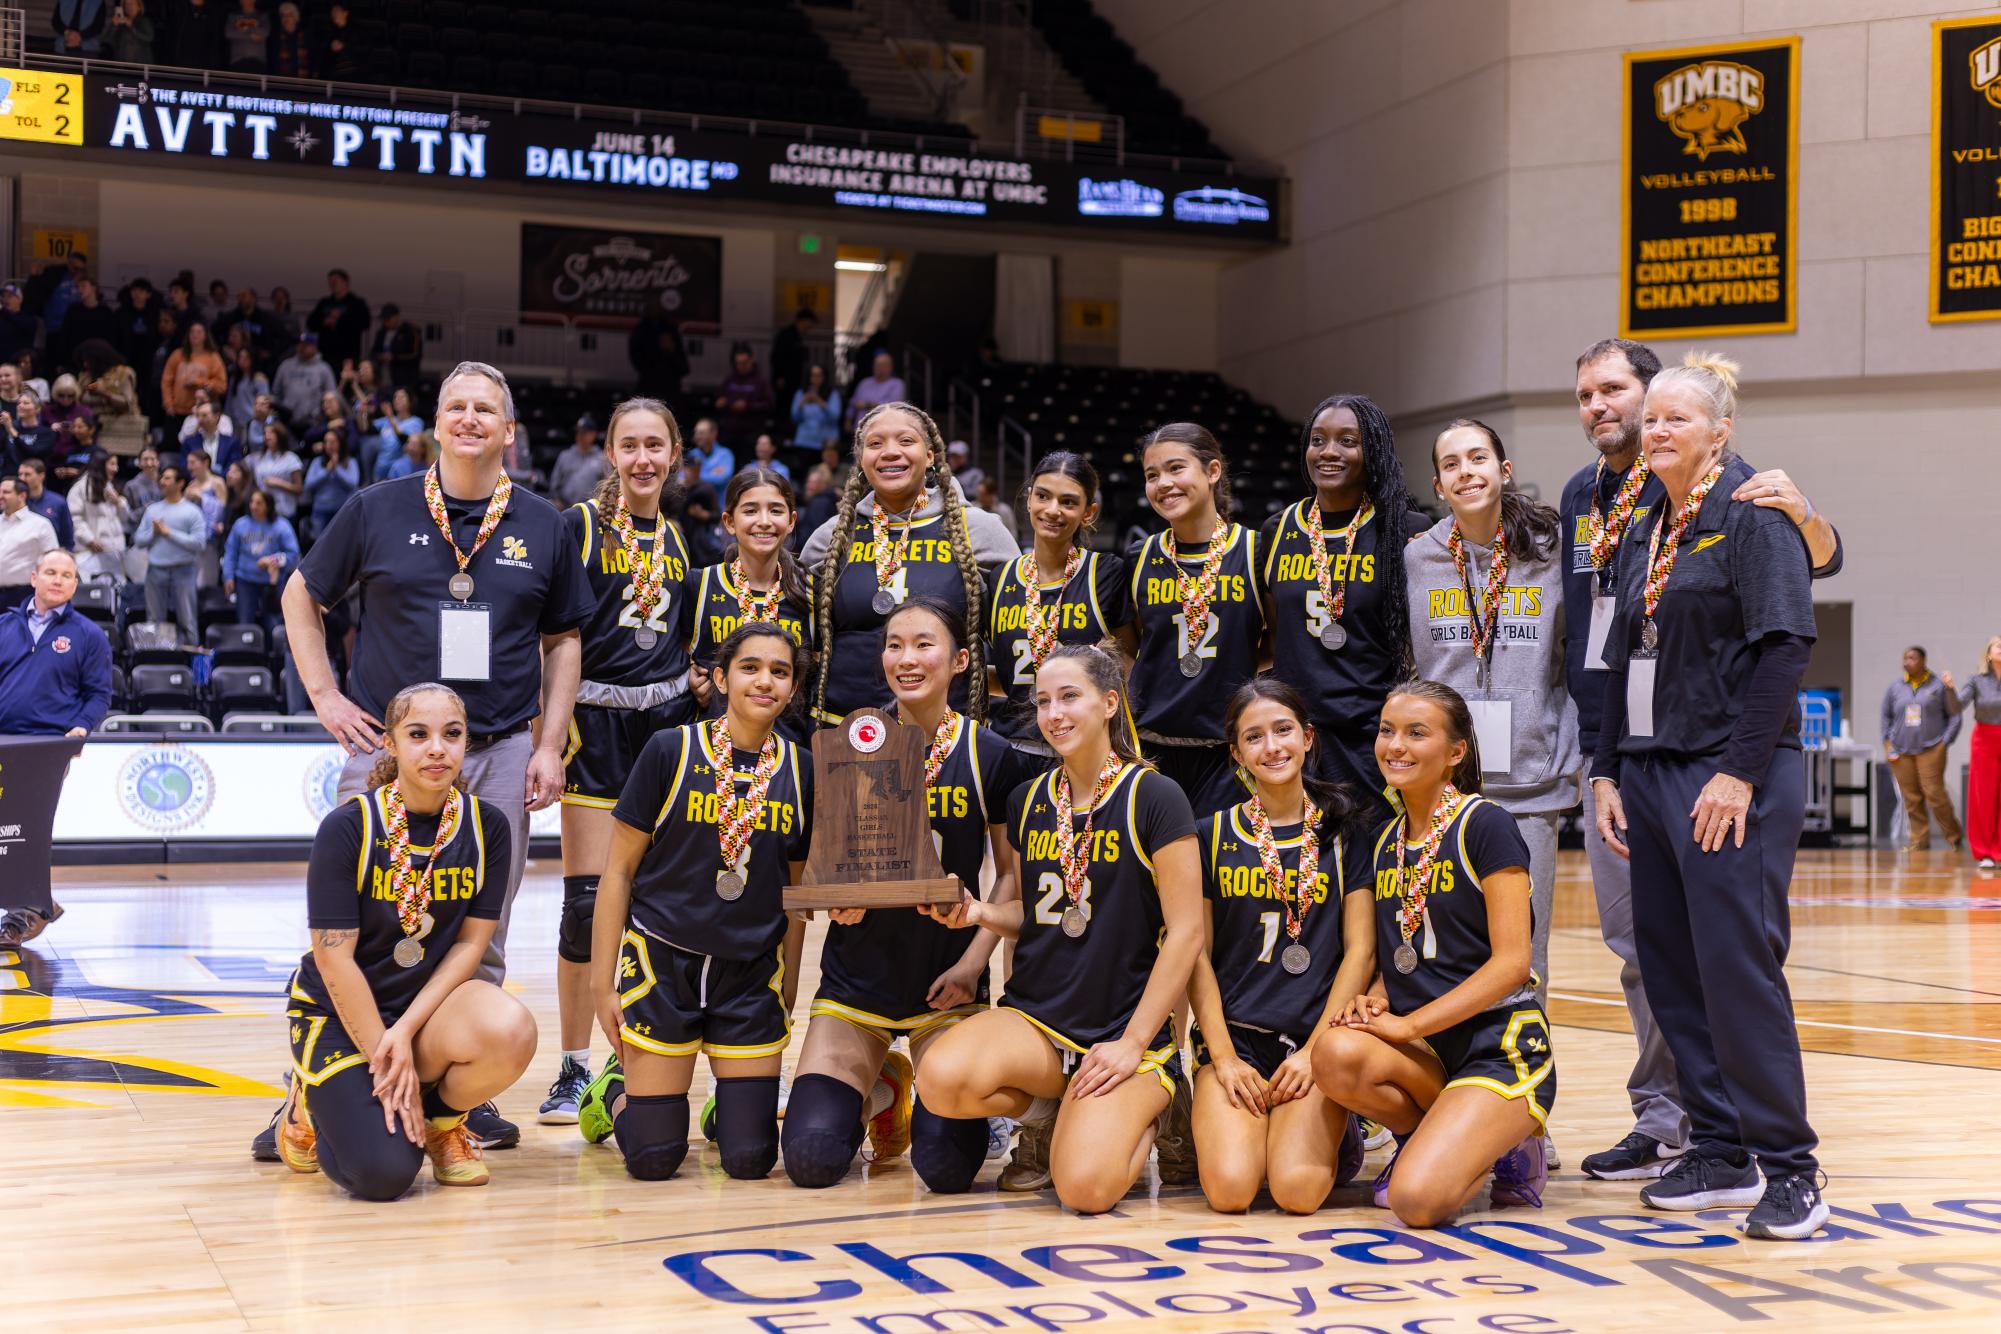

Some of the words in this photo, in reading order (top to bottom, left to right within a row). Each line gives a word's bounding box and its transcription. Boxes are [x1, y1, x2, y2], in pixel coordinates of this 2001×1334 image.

[16, 82, 41, 94] FLS
[54, 83, 70, 105] 2
[151, 88, 178, 104] THE
[180, 91, 225, 108] AVETT
[226, 95, 293, 115] BROTHERS
[309, 102, 342, 120] MIKE
[1660, 64, 1763, 117] UMBC
[14, 115, 42, 128] TOL
[54, 115, 70, 137] 2
[108, 102, 278, 160] AVTT
[332, 121, 487, 178] PTTN
[592, 131, 646, 155] JUNE
[651, 134, 675, 156] 14
[1952, 146, 2001, 164] VOL
[525, 145, 711, 190] BALTIMORE
[786, 143, 916, 173] CHESAPEAKE
[919, 153, 1033, 183] EMPLOYERS
[1640, 166, 1776, 190] VOLLEYBALL
[769, 163, 884, 192] INSURANCE
[888, 172, 956, 198] ARENA
[960, 179, 989, 200] AT
[992, 184, 1049, 206] UMBC
[1679, 197, 1737, 224] 1998
[49, 239, 73, 257] 107
[1639, 232, 1776, 262] NORTHEAST
[553, 252, 691, 303] Sorrento
[1635, 256, 1780, 285] CONFERENCE
[1635, 278, 1780, 310] CHAMPIONS
[496, 557, 533, 570] BASKETBALL
[600, 546, 685, 583] ROKTS
[848, 539, 952, 565] ROKETS
[878, 567, 909, 605] 4
[1147, 574, 1246, 606] ROTS
[618, 583, 671, 633] 22
[997, 602, 1088, 634] ROKTS
[1305, 589, 1333, 638] 5
[709, 615, 803, 648] ROTS
[1171, 611, 1220, 660] 12
[1430, 625, 1457, 641] GIRLS
[1460, 623, 1539, 641] BETBALL
[686, 789, 795, 836] ROETS
[847, 847, 898, 858] STATE
[848, 833, 896, 841] BASKETBALL
[1026, 829, 1120, 863] ROCTS
[835, 861, 912, 872] FINALIST
[1375, 859, 1455, 902] ROCTS
[371, 864, 475, 903] ROETS
[1035, 871, 1092, 925] 23
[1218, 864, 1330, 905] ROCKES
[1257, 911, 1281, 964] 1
